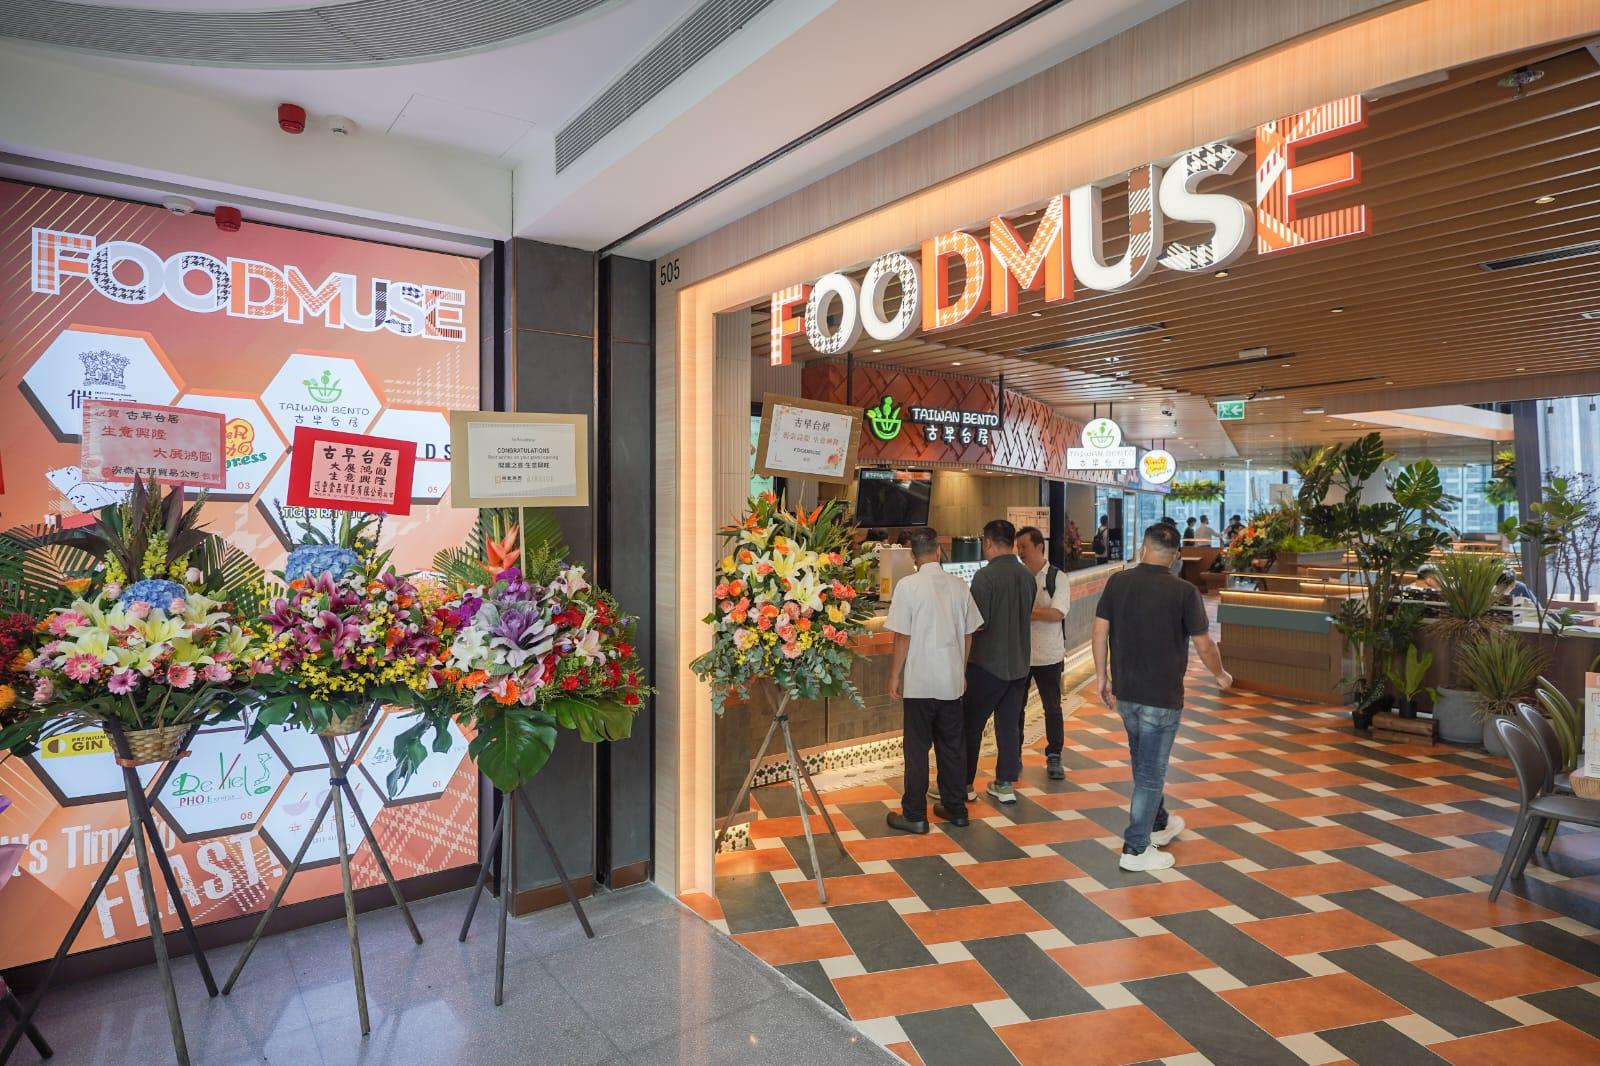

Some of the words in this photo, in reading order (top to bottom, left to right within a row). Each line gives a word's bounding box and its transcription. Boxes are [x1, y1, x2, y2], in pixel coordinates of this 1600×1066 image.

[770, 94, 1372, 366] FOODMUSE
[660, 257, 680, 285] 505
[31, 227, 467, 342] FOODMUSE
[279, 402, 328, 413] TAIWAN
[332, 406, 370, 416] BENTO
[125, 410, 180, 424] 古早台居
[294, 414, 358, 428] 古早台居
[912, 408, 960, 422] TAIWAN
[962, 412, 999, 426] BENTO
[101, 425, 168, 441] 生意興隆
[926, 424, 989, 445] 古早台居
[323, 445, 393, 467] 古早台居
[237, 481, 251, 490] 03
[427, 486, 438, 494] 05
[283, 507, 317, 518] TIGR
[72, 740, 103, 751] GIN
[240, 812, 253, 820] 08
